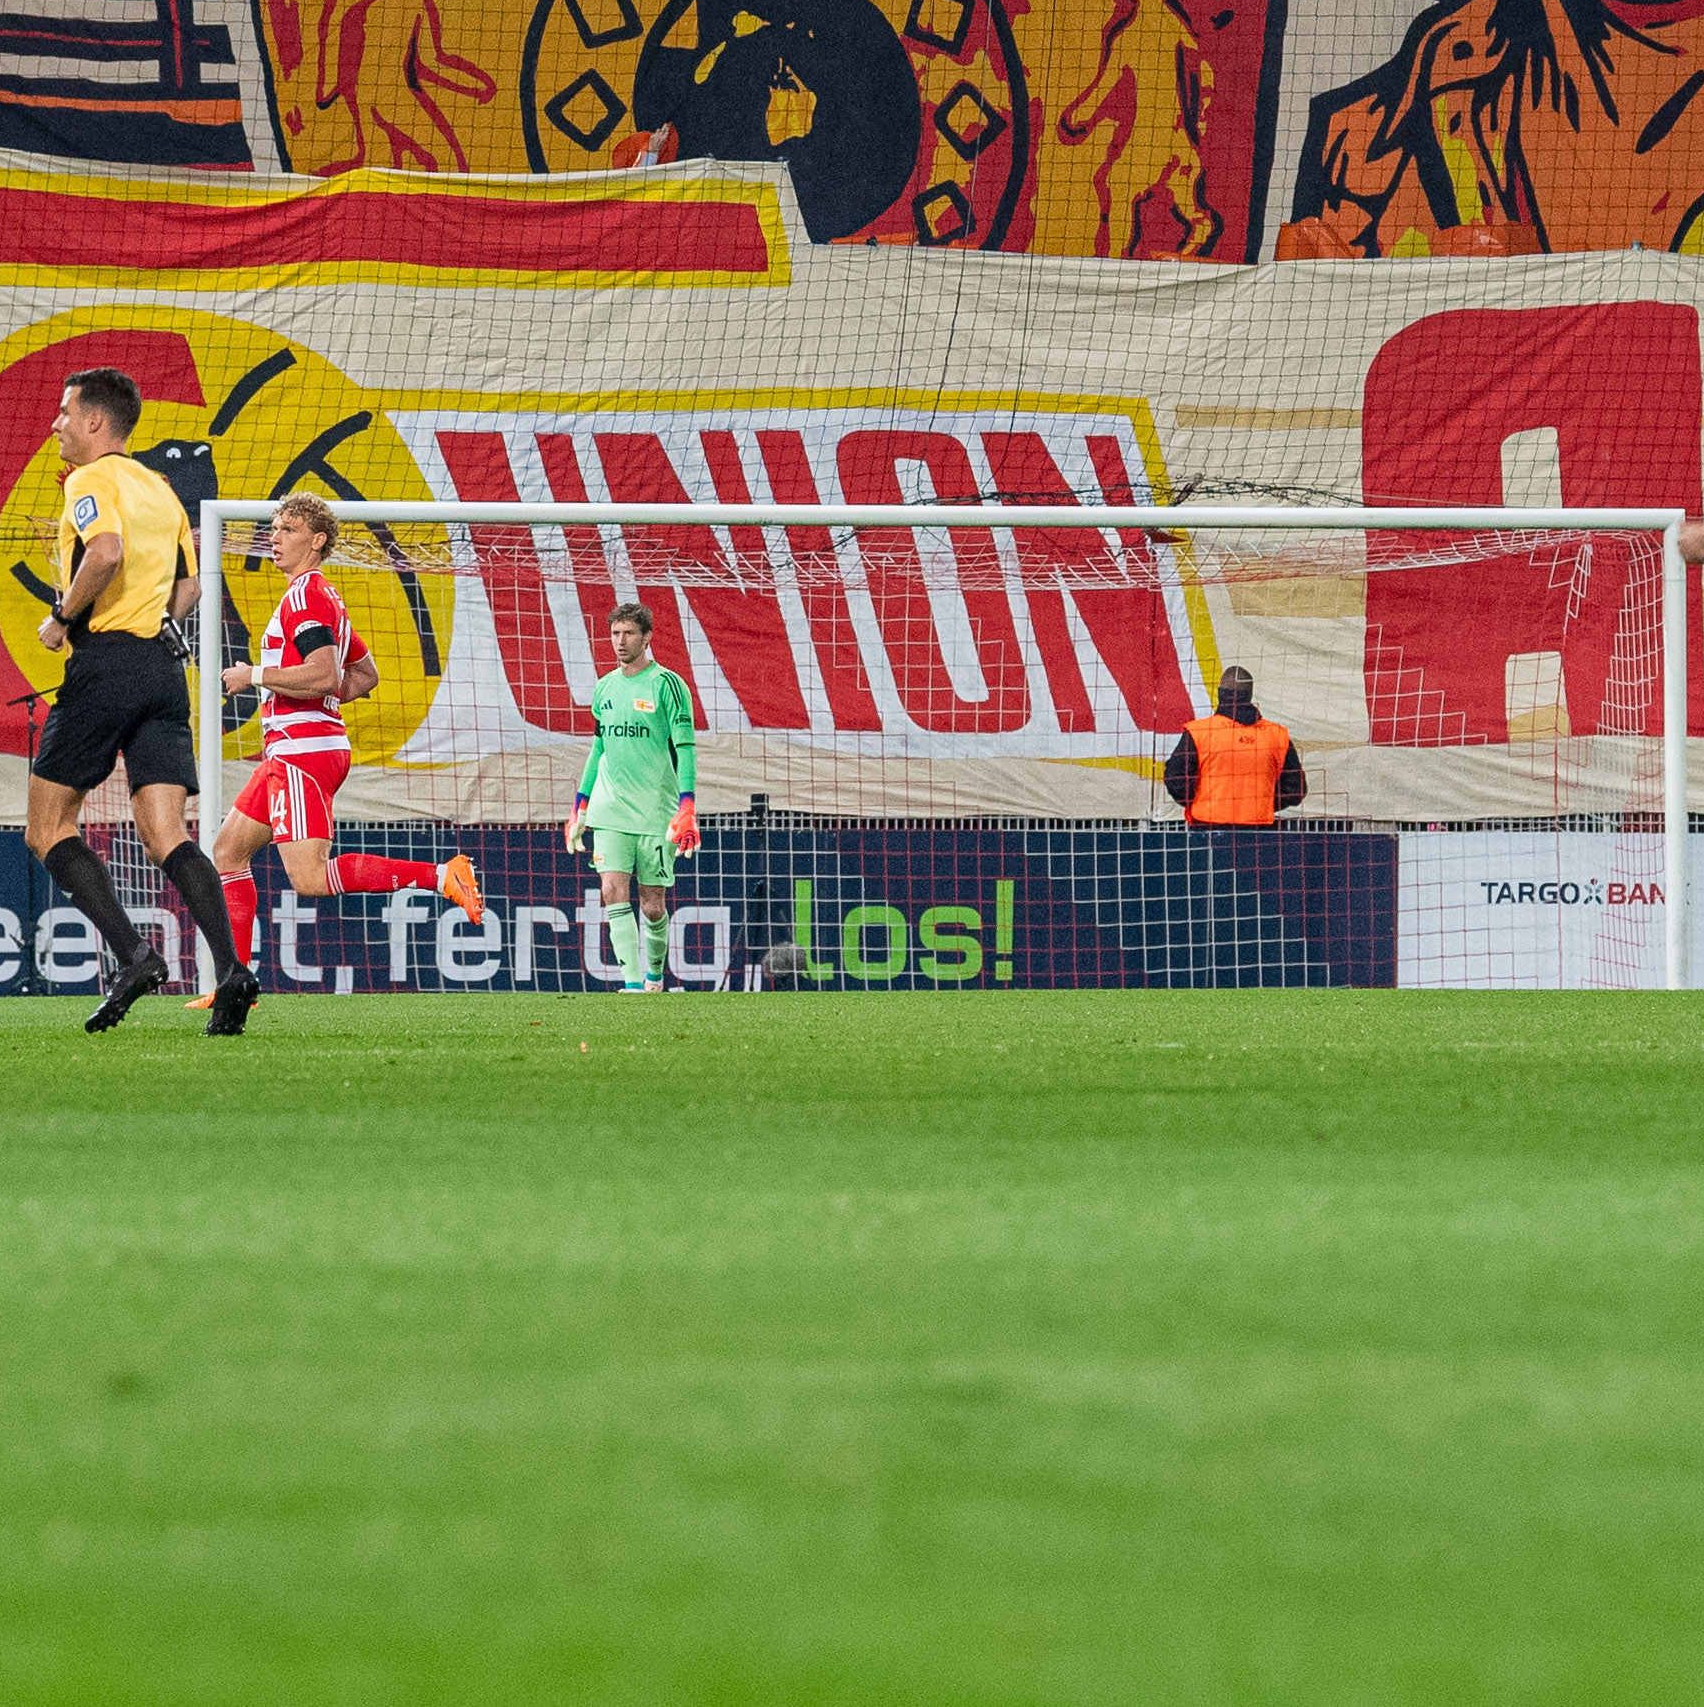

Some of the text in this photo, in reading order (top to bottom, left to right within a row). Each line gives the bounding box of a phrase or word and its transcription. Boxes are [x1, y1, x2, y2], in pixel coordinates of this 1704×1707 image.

[435, 428, 1224, 733] UNION
[608, 721, 650, 738] raisin
[655, 844, 665, 868] 1
[1481, 882, 1580, 905] TARGO
[381, 887, 762, 992] fertg,
[795, 879, 1015, 982] los!
